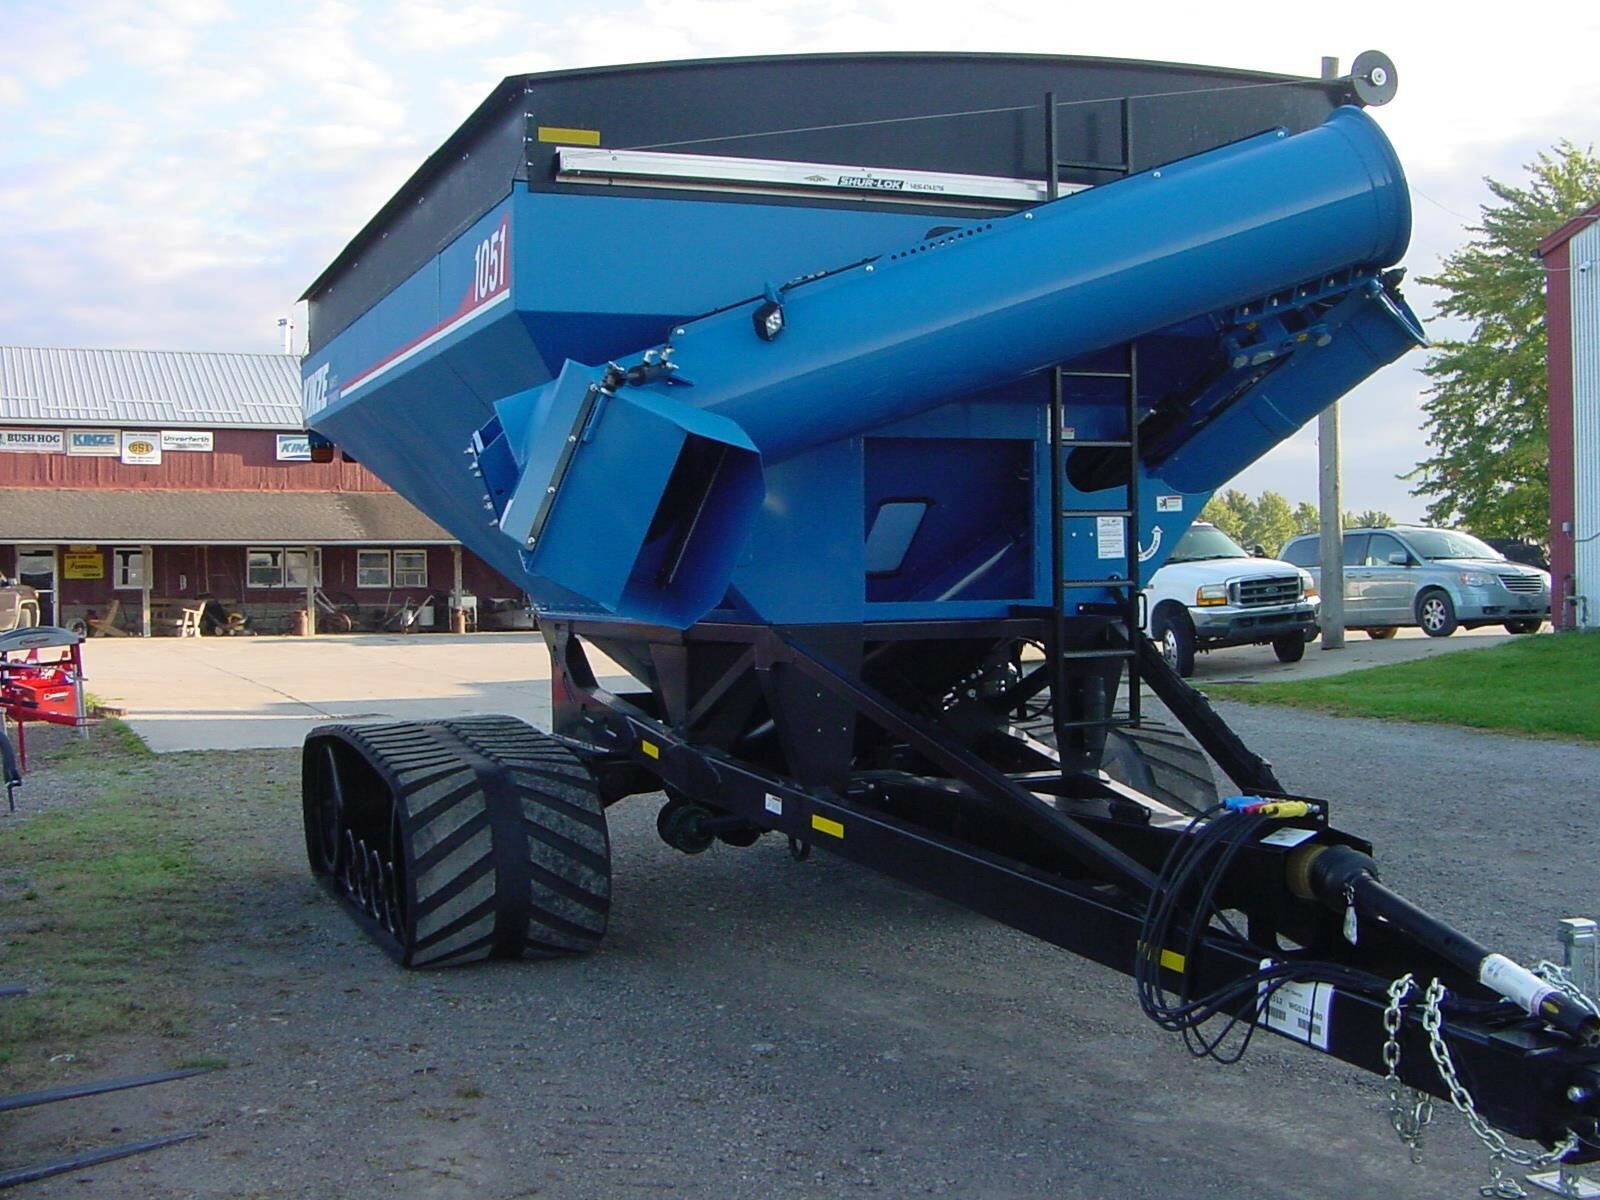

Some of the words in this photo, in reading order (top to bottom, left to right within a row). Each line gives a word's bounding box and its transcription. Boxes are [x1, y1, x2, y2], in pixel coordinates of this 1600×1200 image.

[474, 224, 507, 302] 1051
[7, 433, 36, 442] BUSH
[37, 434, 60, 443] HOG
[73, 434, 115, 445] KINZE
